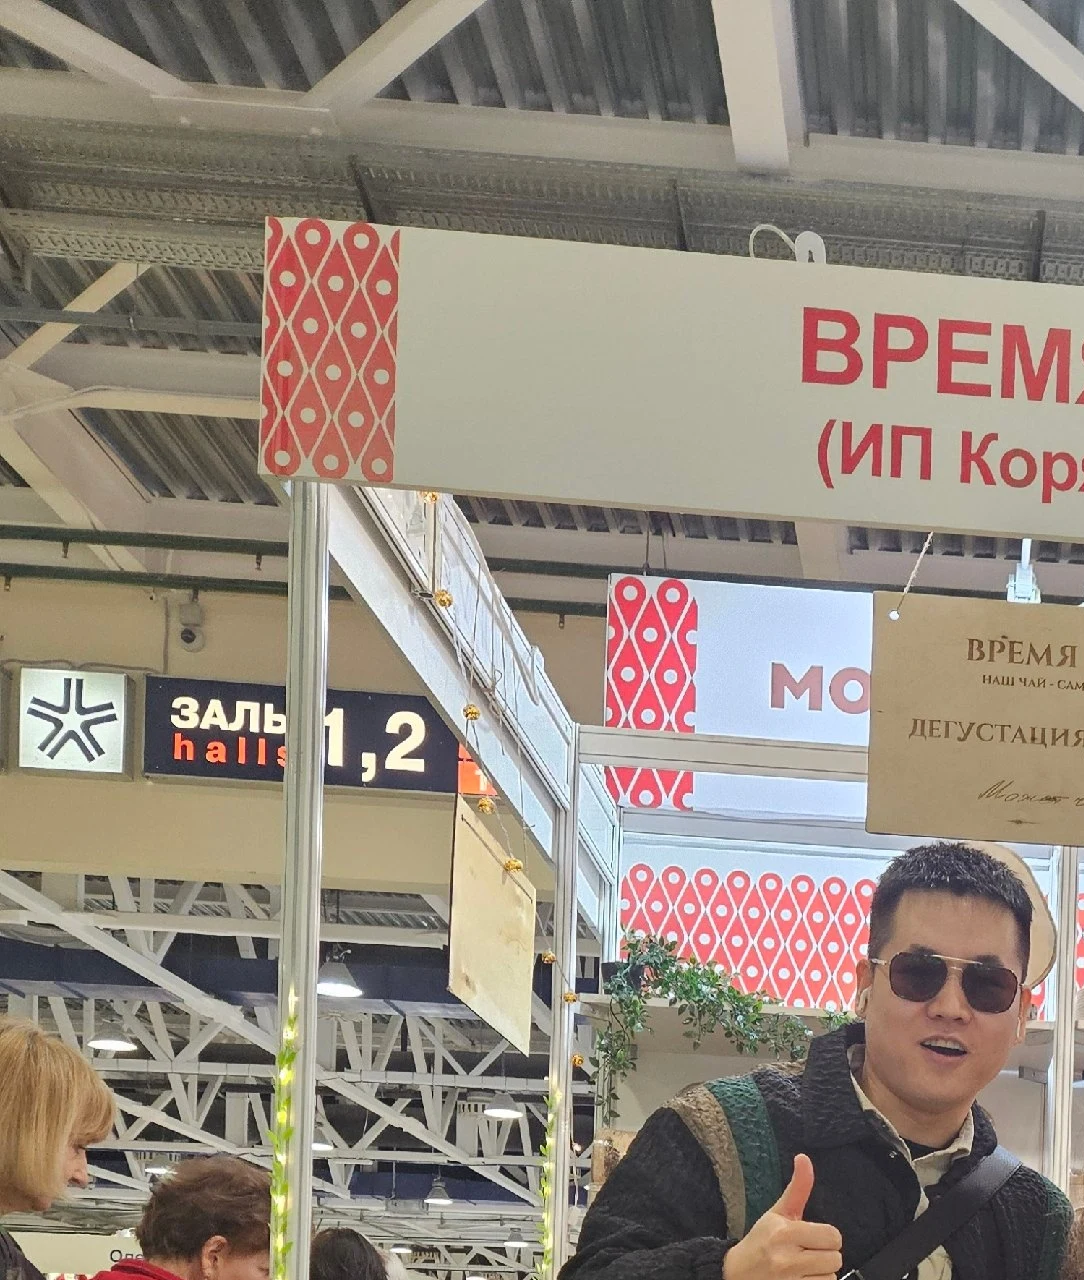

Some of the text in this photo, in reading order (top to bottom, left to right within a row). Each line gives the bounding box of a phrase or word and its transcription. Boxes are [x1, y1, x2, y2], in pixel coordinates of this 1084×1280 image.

[817, 419, 932, 489] (ИП
[966, 637, 1076, 668] ВРЕМЯ
[982, 675, 1015, 687] НАШ
[1019, 675, 1046, 690] ЧАЙ
[324, 707, 427, 783] 1,2
